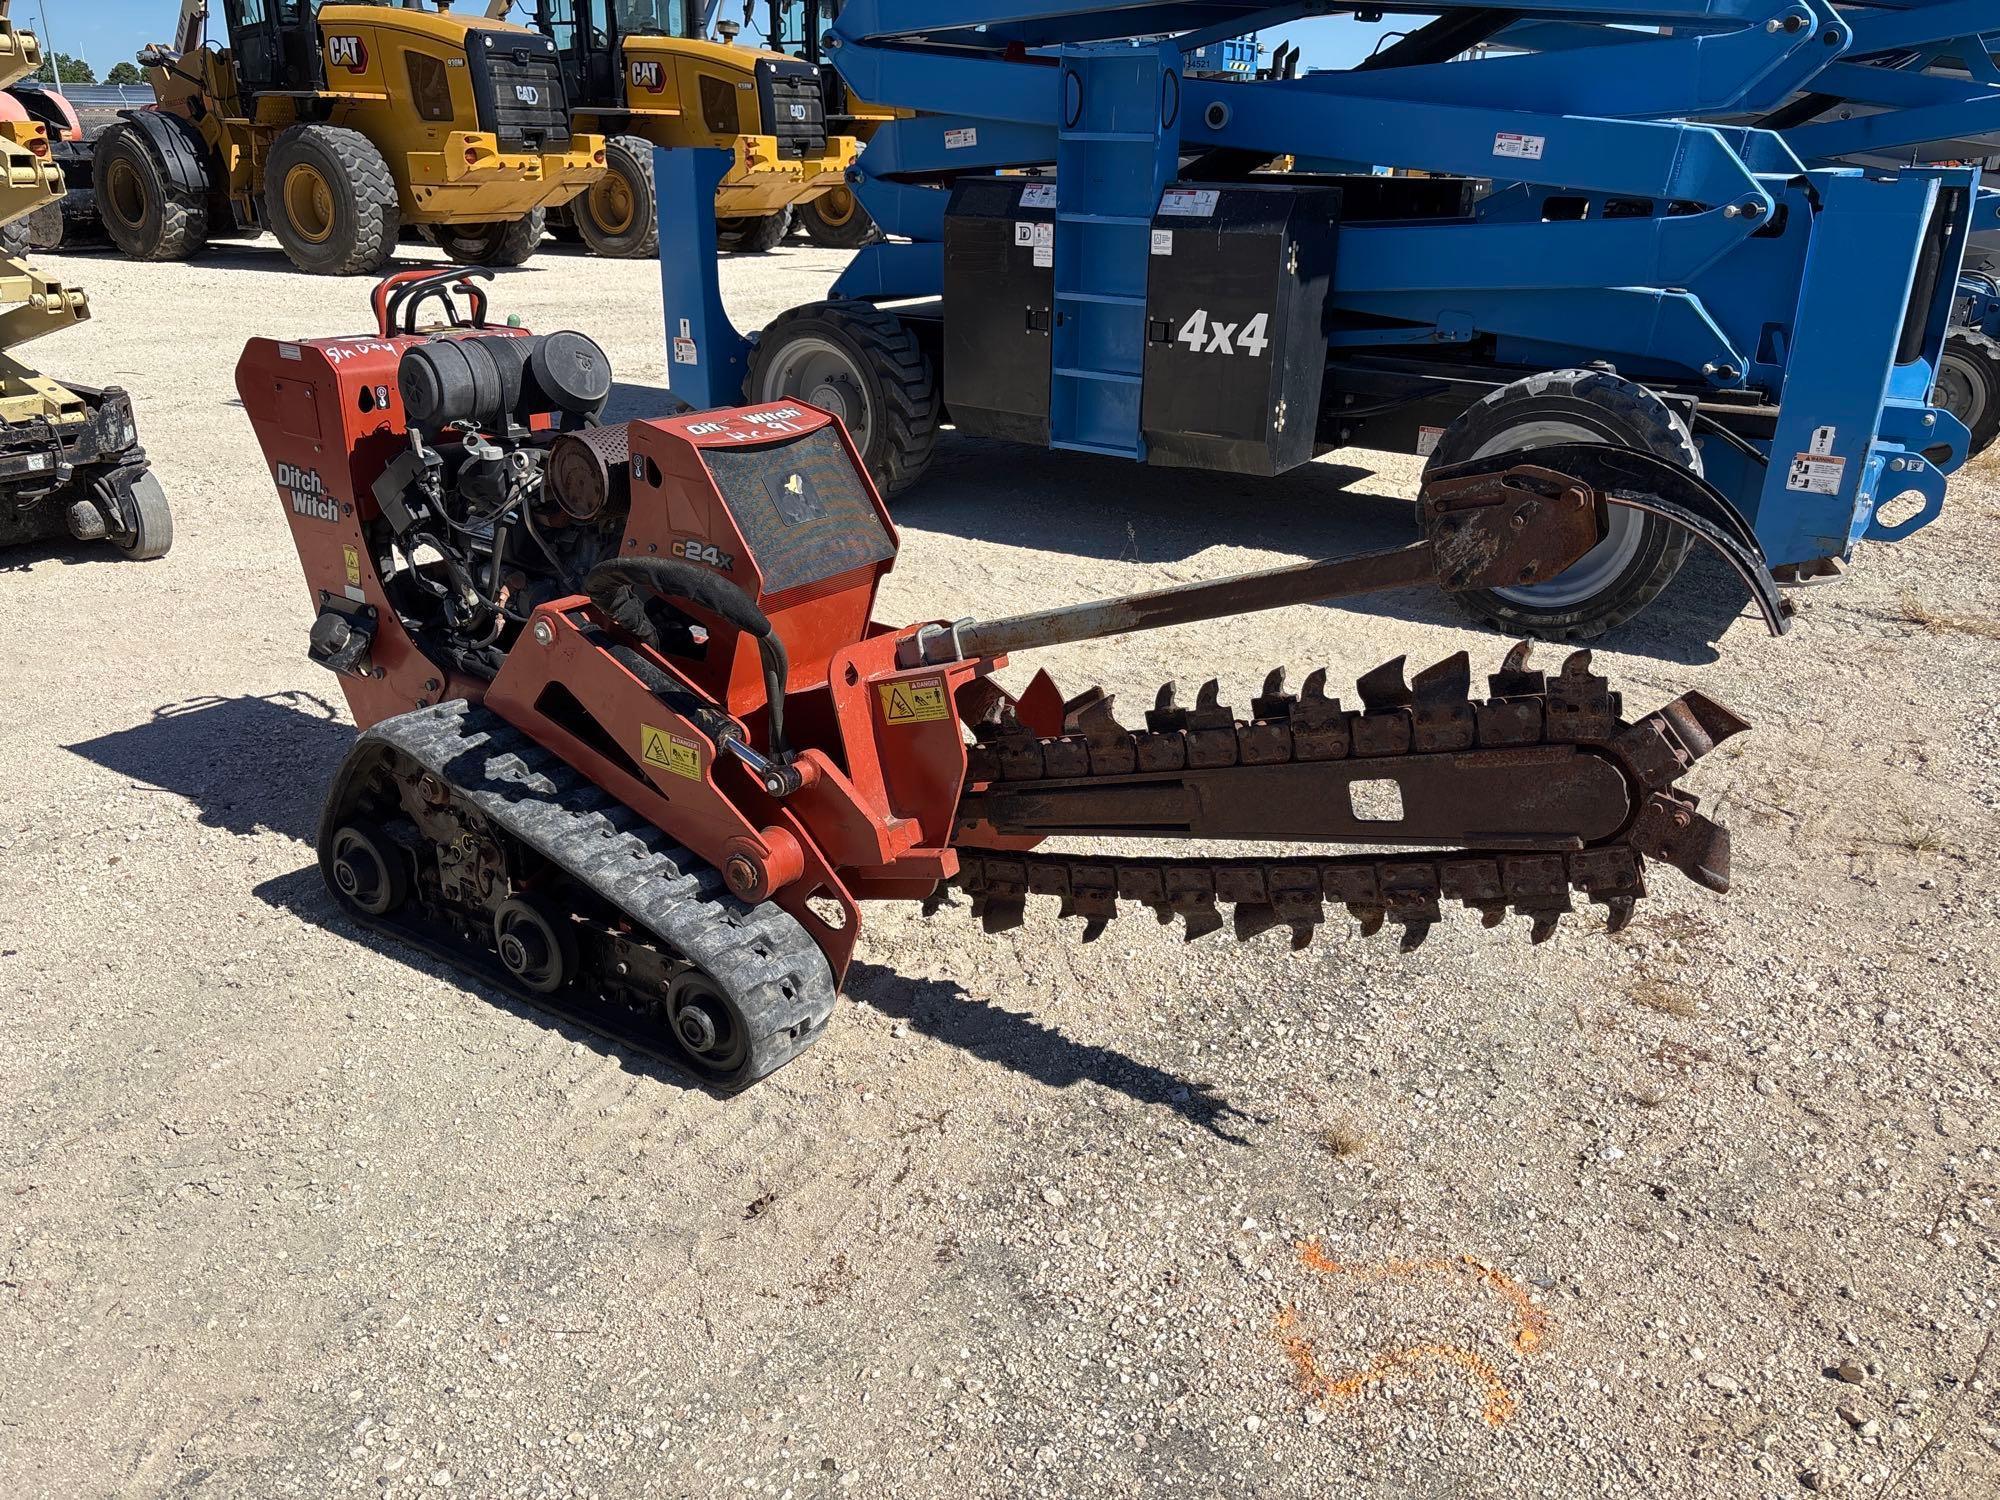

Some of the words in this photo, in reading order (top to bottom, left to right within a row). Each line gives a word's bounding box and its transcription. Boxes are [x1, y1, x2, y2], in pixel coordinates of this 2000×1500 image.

[329, 36, 357, 65] CAT
[631, 62, 658, 86] CAT
[1178, 309, 1269, 357] 4x4
[740, 407, 803, 425] Witch
[277, 463, 321, 494] Ditch
[291, 490, 338, 522] Witch
[917, 680, 939, 688] DANGER
[676, 738, 698, 749] DANGER
